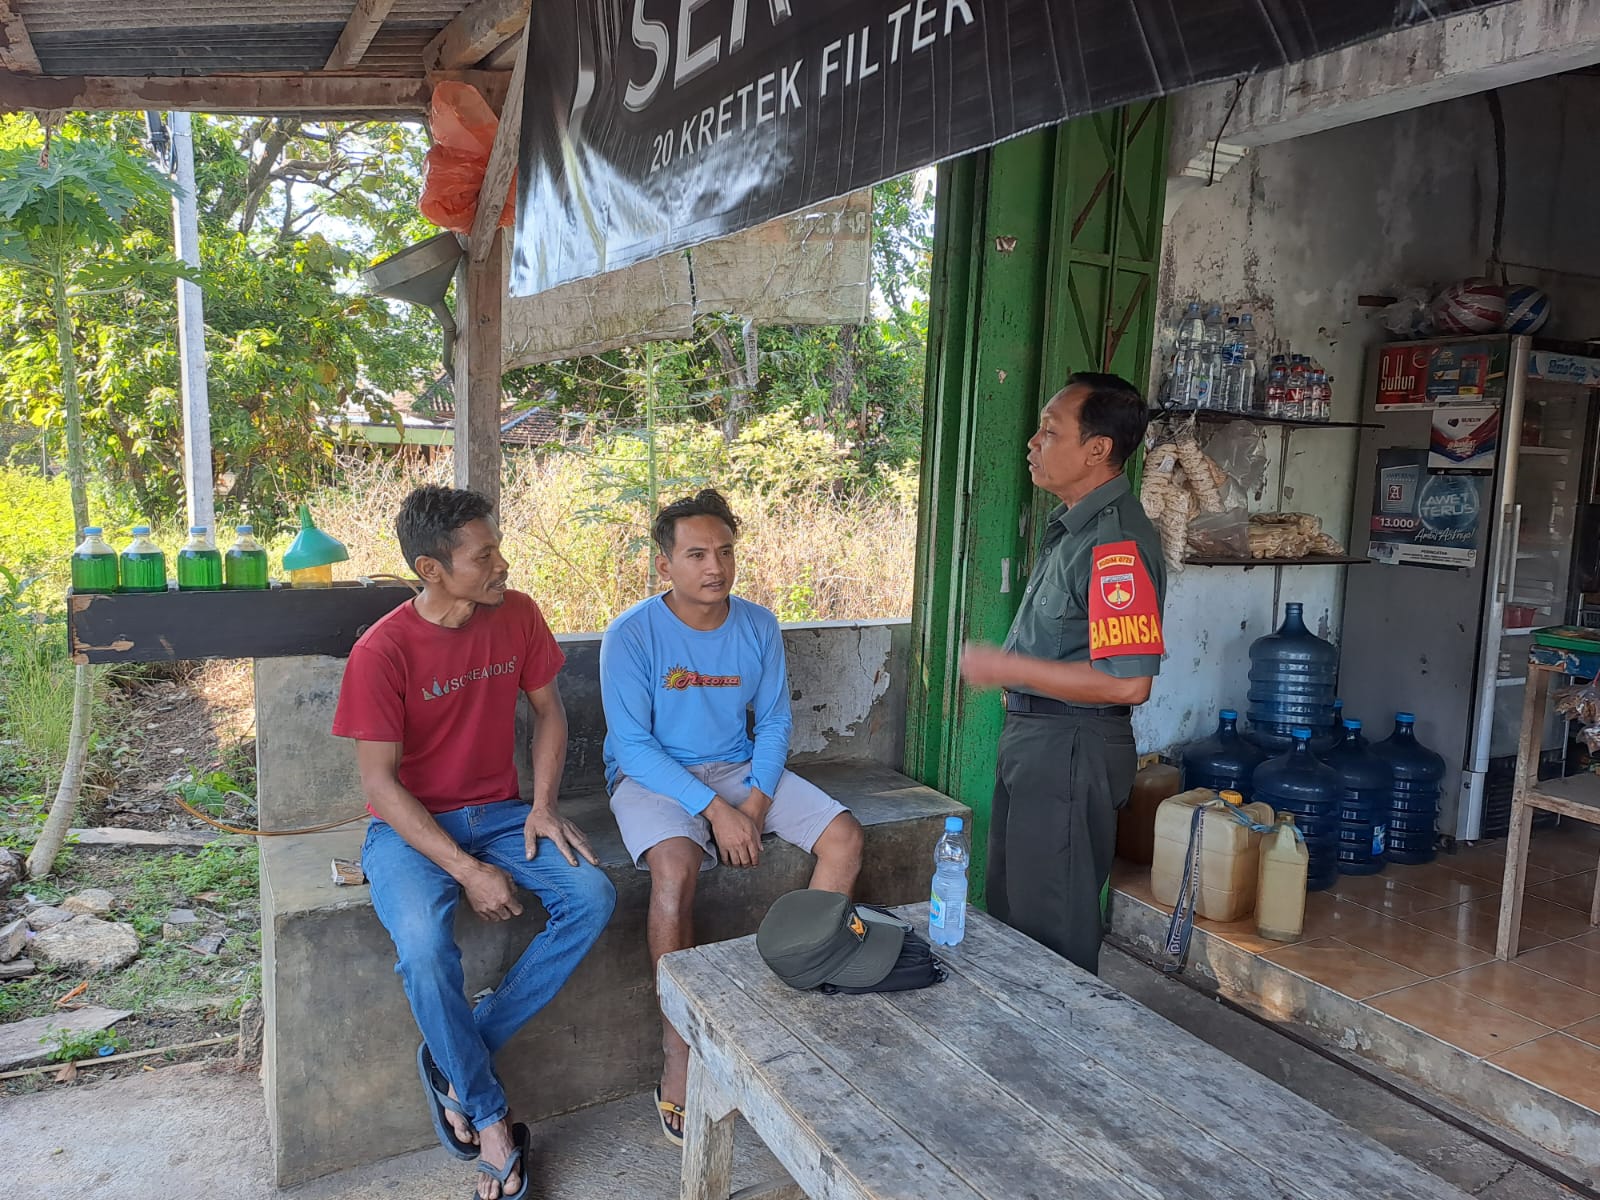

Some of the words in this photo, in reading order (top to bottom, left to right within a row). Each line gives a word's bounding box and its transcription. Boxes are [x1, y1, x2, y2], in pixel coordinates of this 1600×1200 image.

[650, 128, 674, 173] 20
[679, 57, 804, 160] KRETEK
[820, 0, 975, 98] FILTER
[1379, 516, 1414, 529] 13.000
[1421, 503, 1475, 517] TERUS
[1090, 614, 1161, 650] BABINSA
